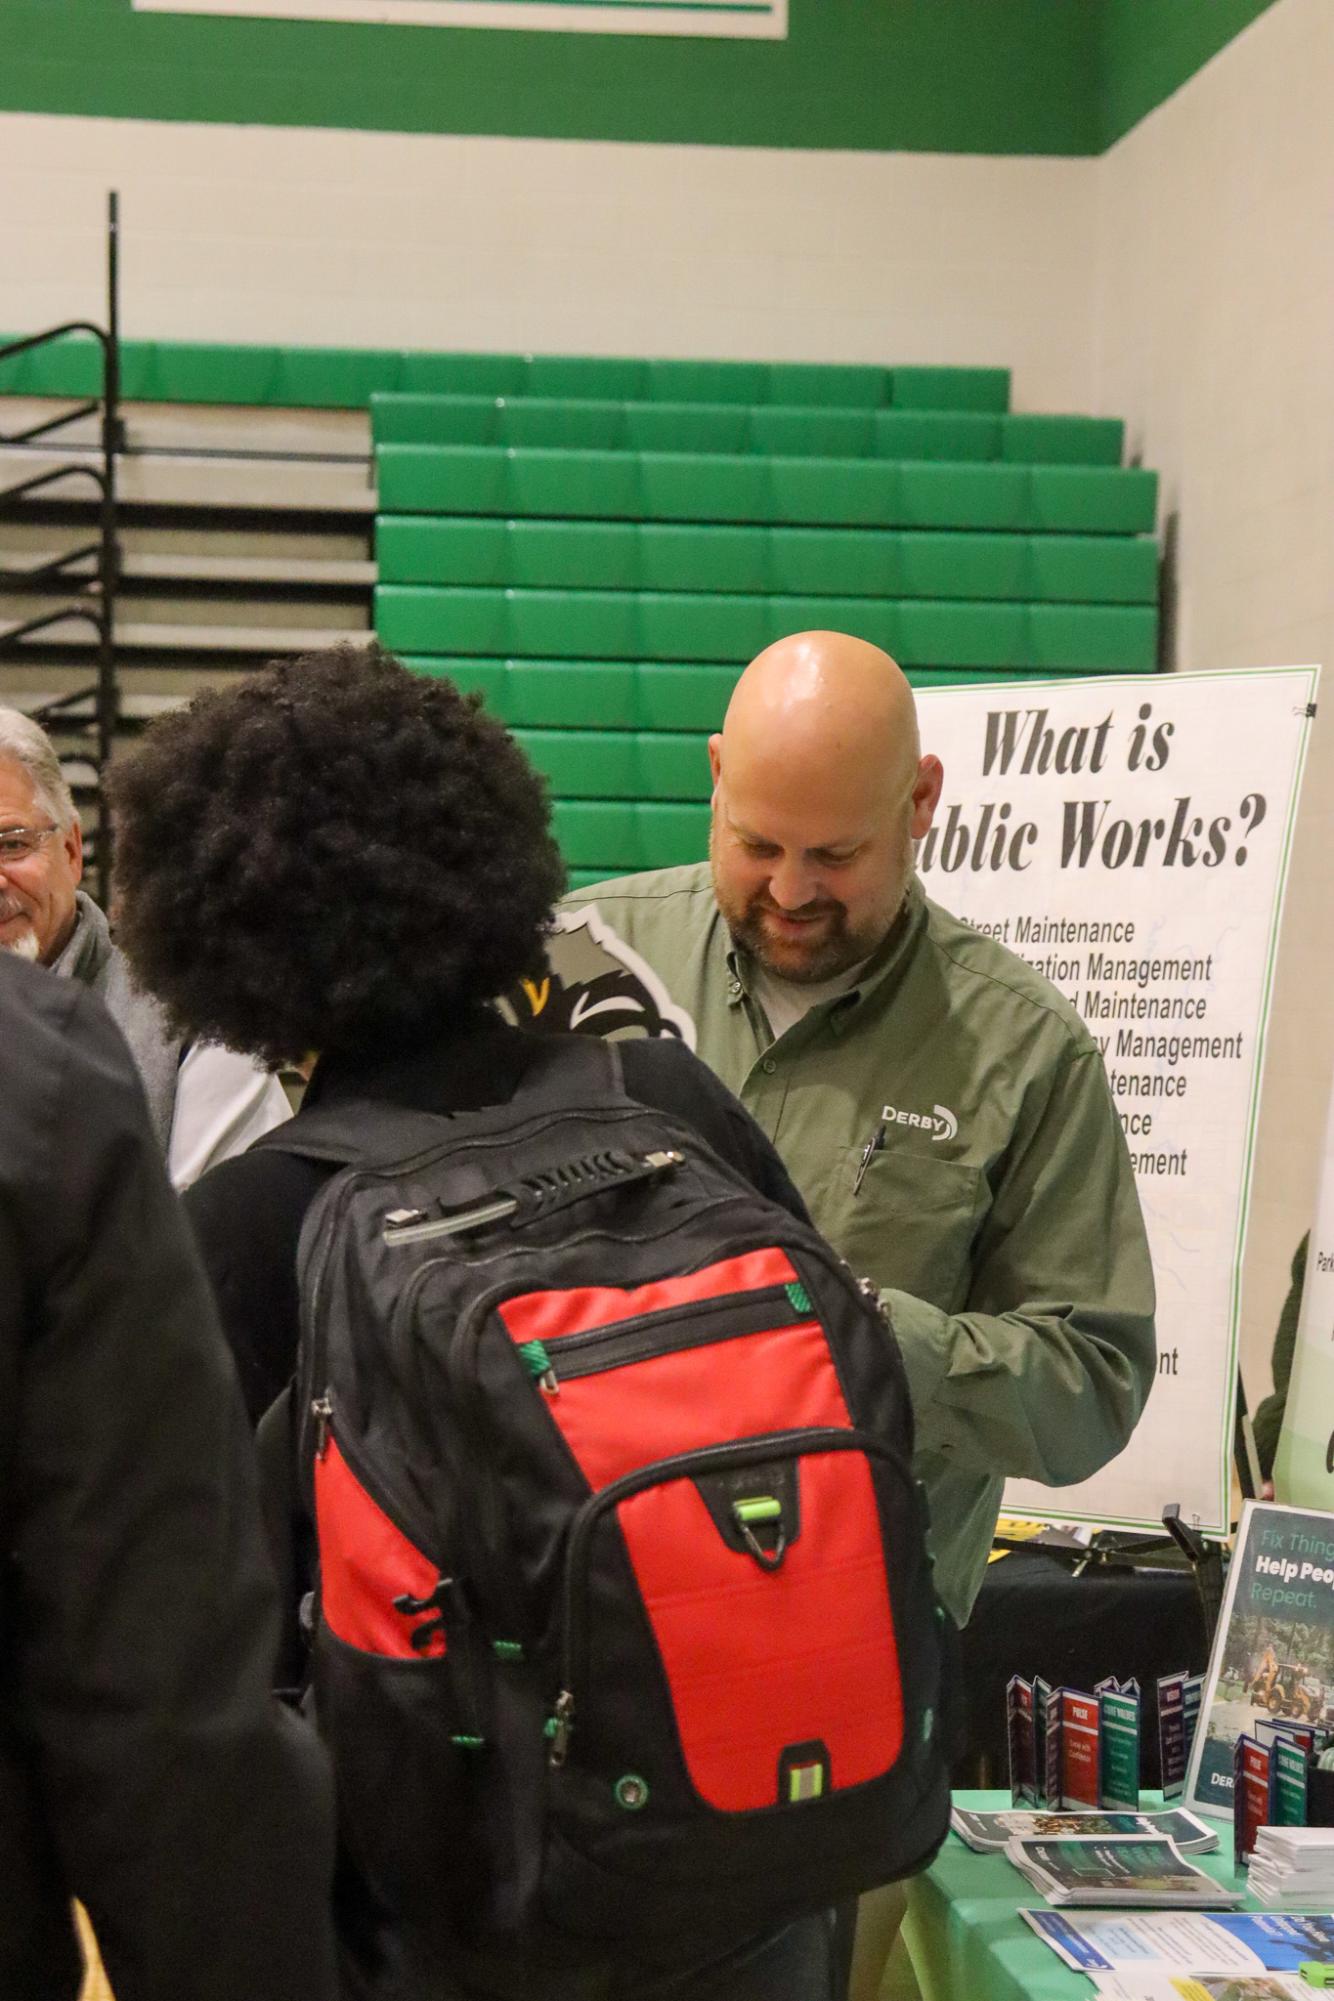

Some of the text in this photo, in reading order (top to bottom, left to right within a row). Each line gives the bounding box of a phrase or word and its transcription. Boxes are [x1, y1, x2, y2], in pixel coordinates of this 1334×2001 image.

[982, 703, 1175, 776] What is
[914, 793, 1267, 873] ublic Works?
[1014, 916, 1135, 943] Maintenance
[1086, 953, 1212, 988] Management
[1083, 991, 1206, 1019] Maintenance
[1115, 1029, 1243, 1066] Management
[1110, 1069, 1187, 1097] tenance
[881, 1105, 944, 1131] DERBY
[1261, 1530, 1284, 1548] Fix
[1255, 1555, 1334, 1591] Help Peo
[1251, 1582, 1317, 1608] Repeat.
[1210, 1772, 1234, 1788] DER
